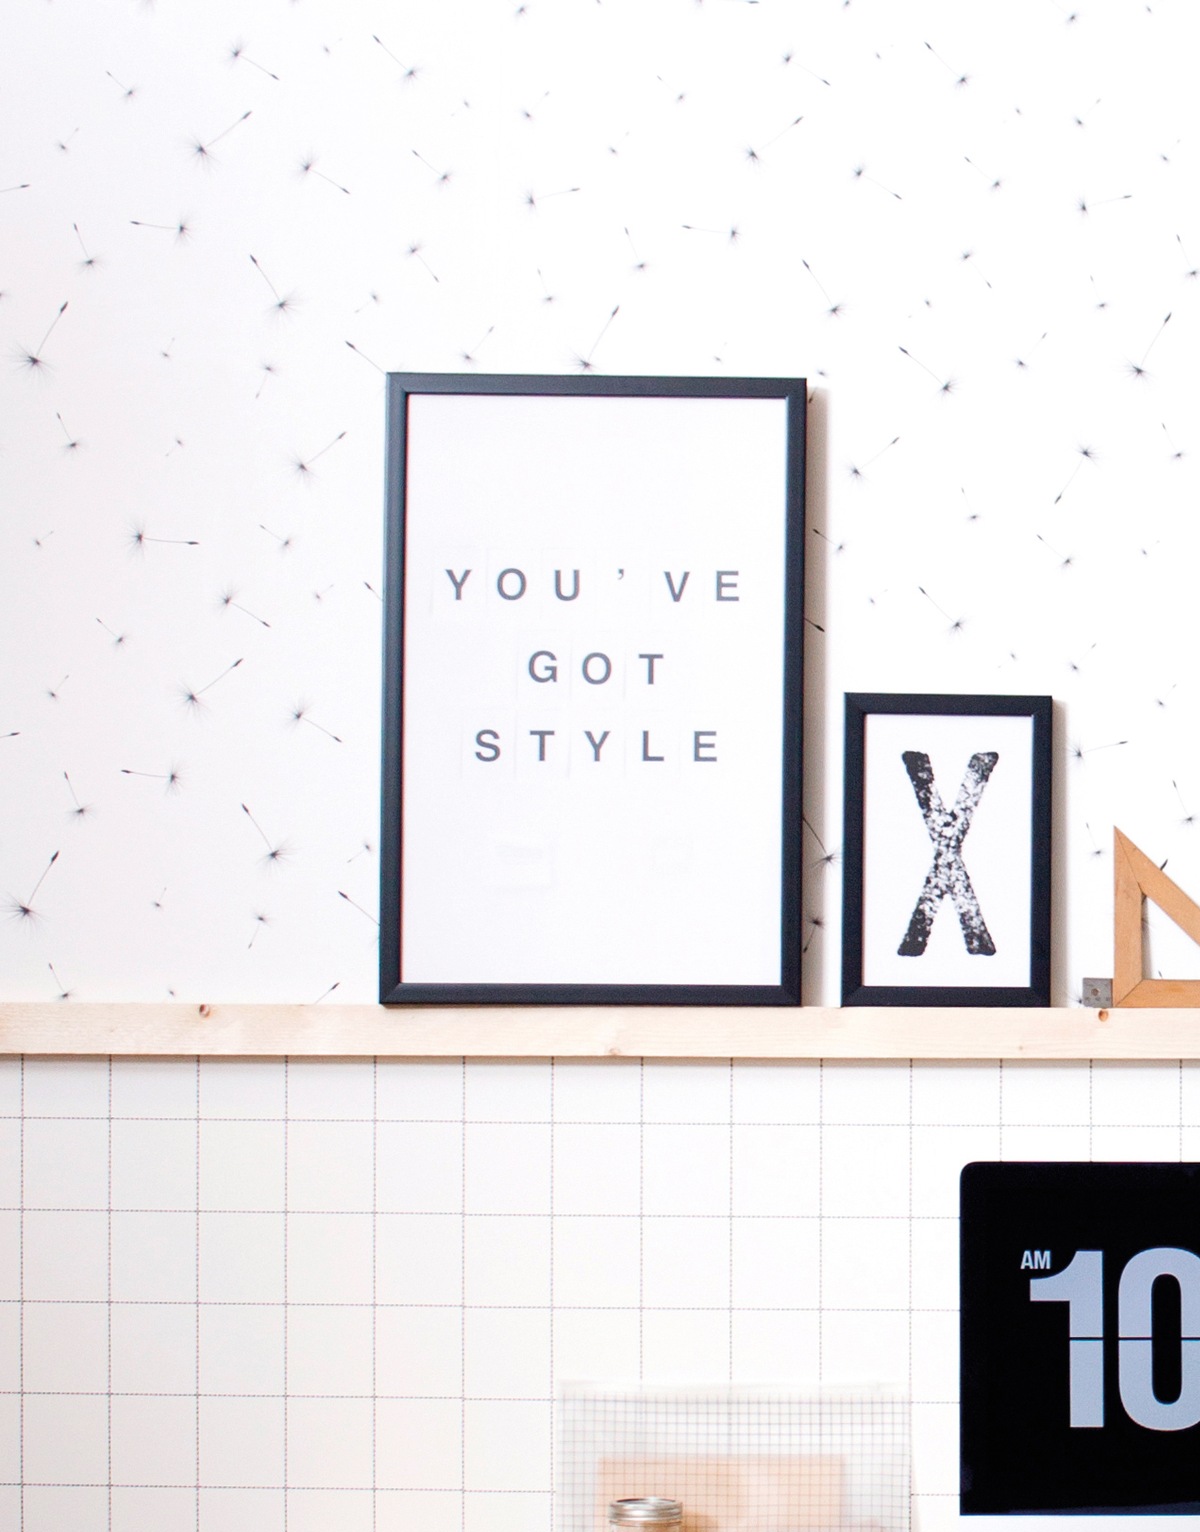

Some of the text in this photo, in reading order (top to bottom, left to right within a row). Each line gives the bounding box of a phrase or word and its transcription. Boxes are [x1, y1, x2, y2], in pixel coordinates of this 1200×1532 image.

[445, 567, 740, 603] YOU'VE
[528, 650, 664, 685] GOT
[475, 729, 718, 763] STYLE
[896, 750, 1000, 958] X
[1020, 1250, 1051, 1270] AM
